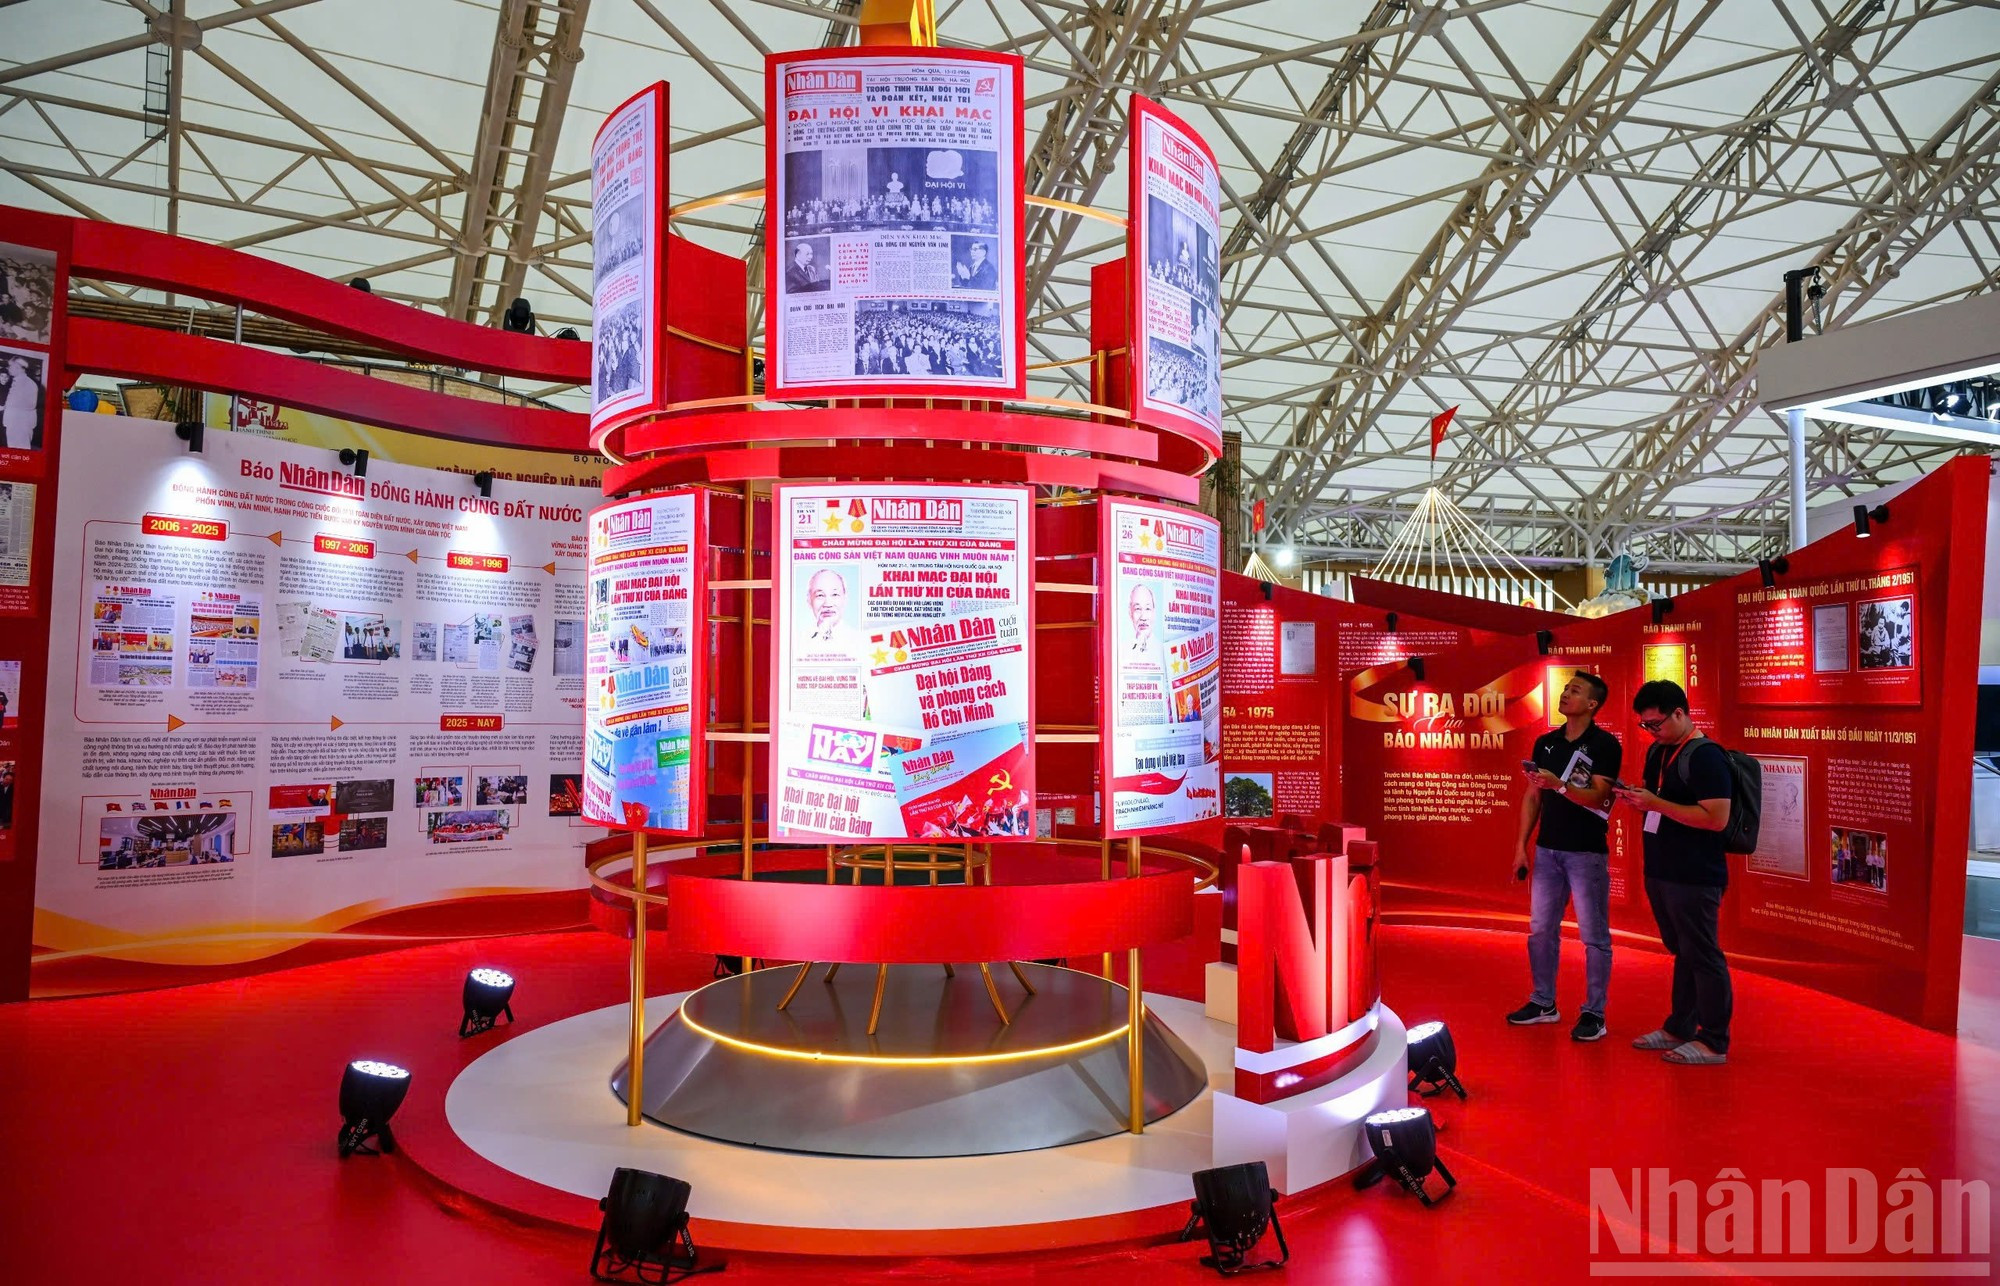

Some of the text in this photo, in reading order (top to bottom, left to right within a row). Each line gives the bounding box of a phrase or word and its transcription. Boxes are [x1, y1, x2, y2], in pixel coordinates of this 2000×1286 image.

[788, 71, 856, 91] Nhân Dân
[788, 106, 992, 122] ĐẠI HỘI VI KHAI MẠC
[1163, 136, 1189, 165] Nhân
[241, 459, 582, 523] Báo Nhân Dân ĐỒNG HÀNH CÙNG ĐẤT NƯỚC
[275, 497, 296, 507] TRONG
[872, 500, 922, 520] Nhân
[925, 500, 962, 520] Dân
[151, 519, 180, 532] 2006
[191, 523, 219, 536] 2025
[610, 509, 650, 533] Nhân Dân
[798, 514, 812, 524] 21
[1122, 530, 1132, 539] 26
[1167, 523, 1189, 545] Nhân
[320, 539, 339, 551] 1997
[349, 543, 369, 554] 2005
[822, 539, 846, 547] CHÀO
[848, 539, 873, 547] MỪNG
[891, 539, 905, 548] HỘI
[907, 538, 926, 546] LẦN
[927, 539, 944, 547] THỨ
[959, 539, 976, 547] CỦA
[977, 540, 1001, 548] ĐẢNG
[453, 555, 473, 566] 1986
[482, 558, 502, 569] 1996
[793, 551, 817, 560] ĐẢNG
[818, 551, 842, 561] CỘNG
[843, 551, 861, 560] SẢN
[863, 551, 882, 561] VIỆT
[885, 552, 905, 560] NAM
[908, 552, 937, 561] QUANG
[940, 552, 960, 560] VINH
[962, 551, 988, 561] MUÔN
[989, 552, 1009, 562] NĂM
[882, 570, 998, 584] KHAI MẠC ĐẠI HỘI
[869, 584, 1010, 599] LẦN THỨ XII CỦA ĐẢNG
[1737, 593, 1751, 605] ĐẠI
[1752, 591, 1765, 603] HỘI
[1767, 589, 1787, 601] ĐẢNG
[1789, 587, 1808, 598] TOÀN
[1810, 582, 1829, 597] QUỐC
[1830, 580, 1844, 594] LẦN
[1846, 578, 1860, 591] THỨ
[1868, 575, 1891, 589] THÁNG
[1892, 572, 1915, 586] 2/1951
[998, 615, 1017, 627] cuối
[1660, 623, 1685, 633] TRANH
[907, 616, 996, 648] Nhân Dân
[1000, 626, 1018, 638] tuần
[1565, 646, 1591, 654] THANH
[1593, 644, 1612, 654] NIÊN
[915, 664, 992, 692] Đại hội Đảng
[918, 680, 1007, 710] và phong cách
[1383, 688, 1505, 719] SỰ RA ĐỜI
[922, 702, 995, 730] Hồ Chí Minh
[1248, 707, 1274, 718] 1975
[446, 718, 468, 727] 2025
[477, 719, 495, 727] NAY
[1384, 728, 1504, 750] BÁO NHÂN DÂN
[1744, 727, 1759, 738] BÁO
[1783, 726, 1799, 739] DÂN
[1801, 725, 1820, 740] XUẤT
[1821, 727, 1836, 741] BẢN
[1837, 726, 1847, 741] SỐ
[1849, 728, 1863, 742] ĐẦU
[1864, 729, 1883, 743] NGÀY
[1884, 731, 1917, 744] 11/3/1951
[902, 749, 954, 773] Nhân Dân
[150, 787, 196, 798] Nhân Dân
[783, 786, 860, 816] Khai mạc Đại hội
[780, 804, 873, 837] lần thứ XII của Đảng
